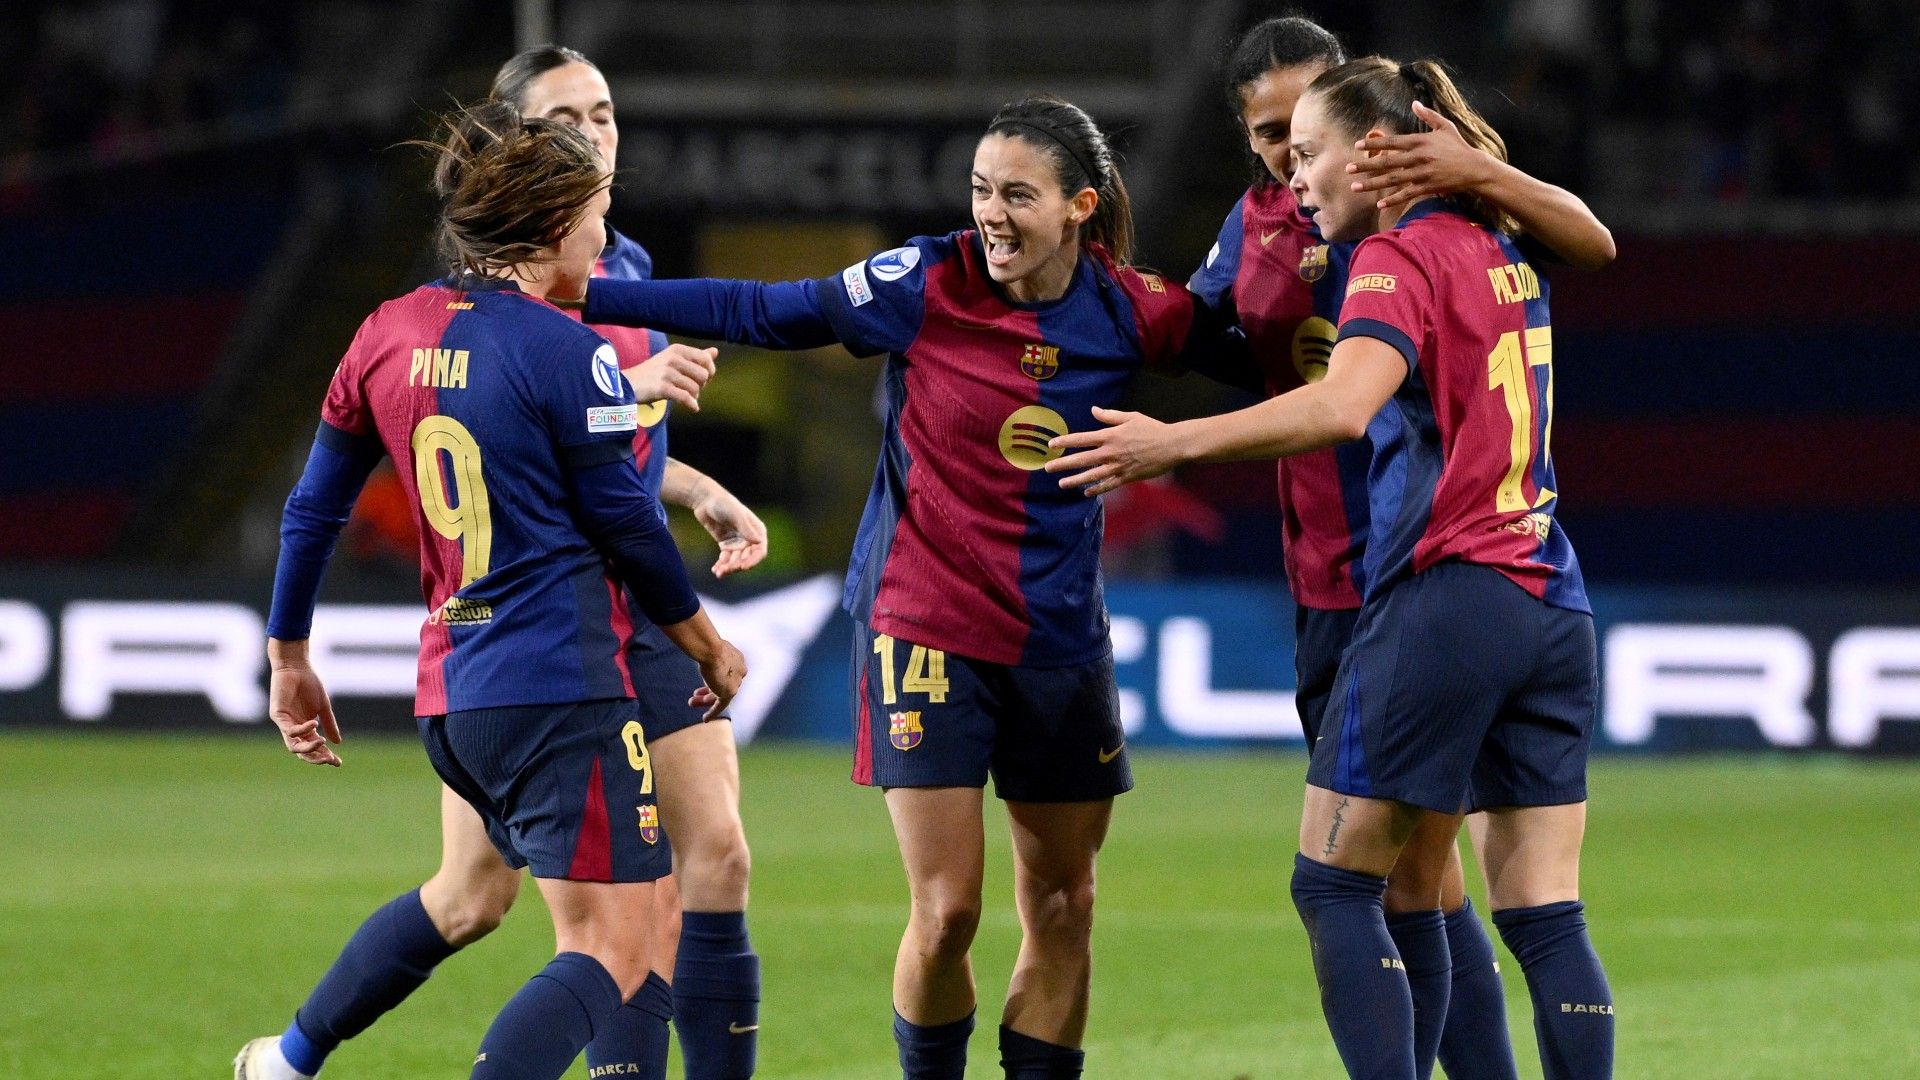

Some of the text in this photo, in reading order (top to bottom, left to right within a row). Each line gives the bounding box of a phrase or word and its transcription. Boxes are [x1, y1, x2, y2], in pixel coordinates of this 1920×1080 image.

[409, 348, 470, 389] PINA
[1488, 326, 1558, 513] 17
[412, 415, 492, 591] 9
[441, 605, 492, 621] ACNUR
[873, 633, 950, 704] 14
[621, 720, 652, 794] 9
